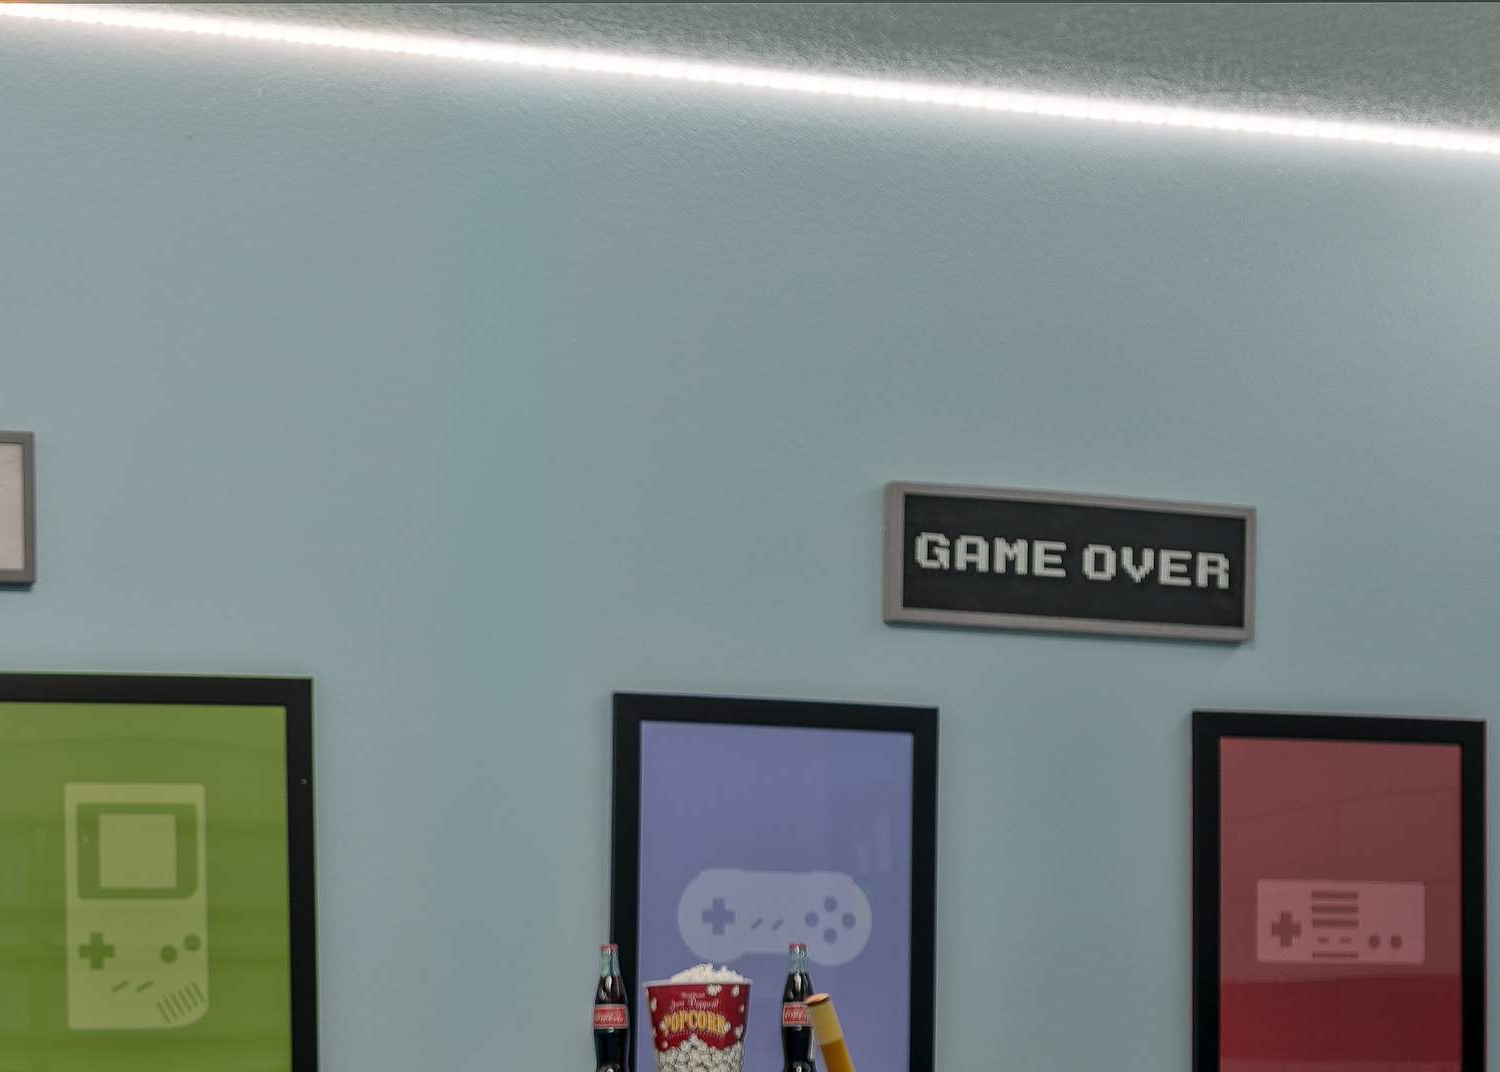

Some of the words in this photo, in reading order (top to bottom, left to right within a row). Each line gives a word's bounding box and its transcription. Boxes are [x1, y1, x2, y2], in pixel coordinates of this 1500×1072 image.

[914, 531, 1067, 578] GAME
[1082, 544, 1230, 590] OVER
[663, 1010, 726, 1036] POPCORN
